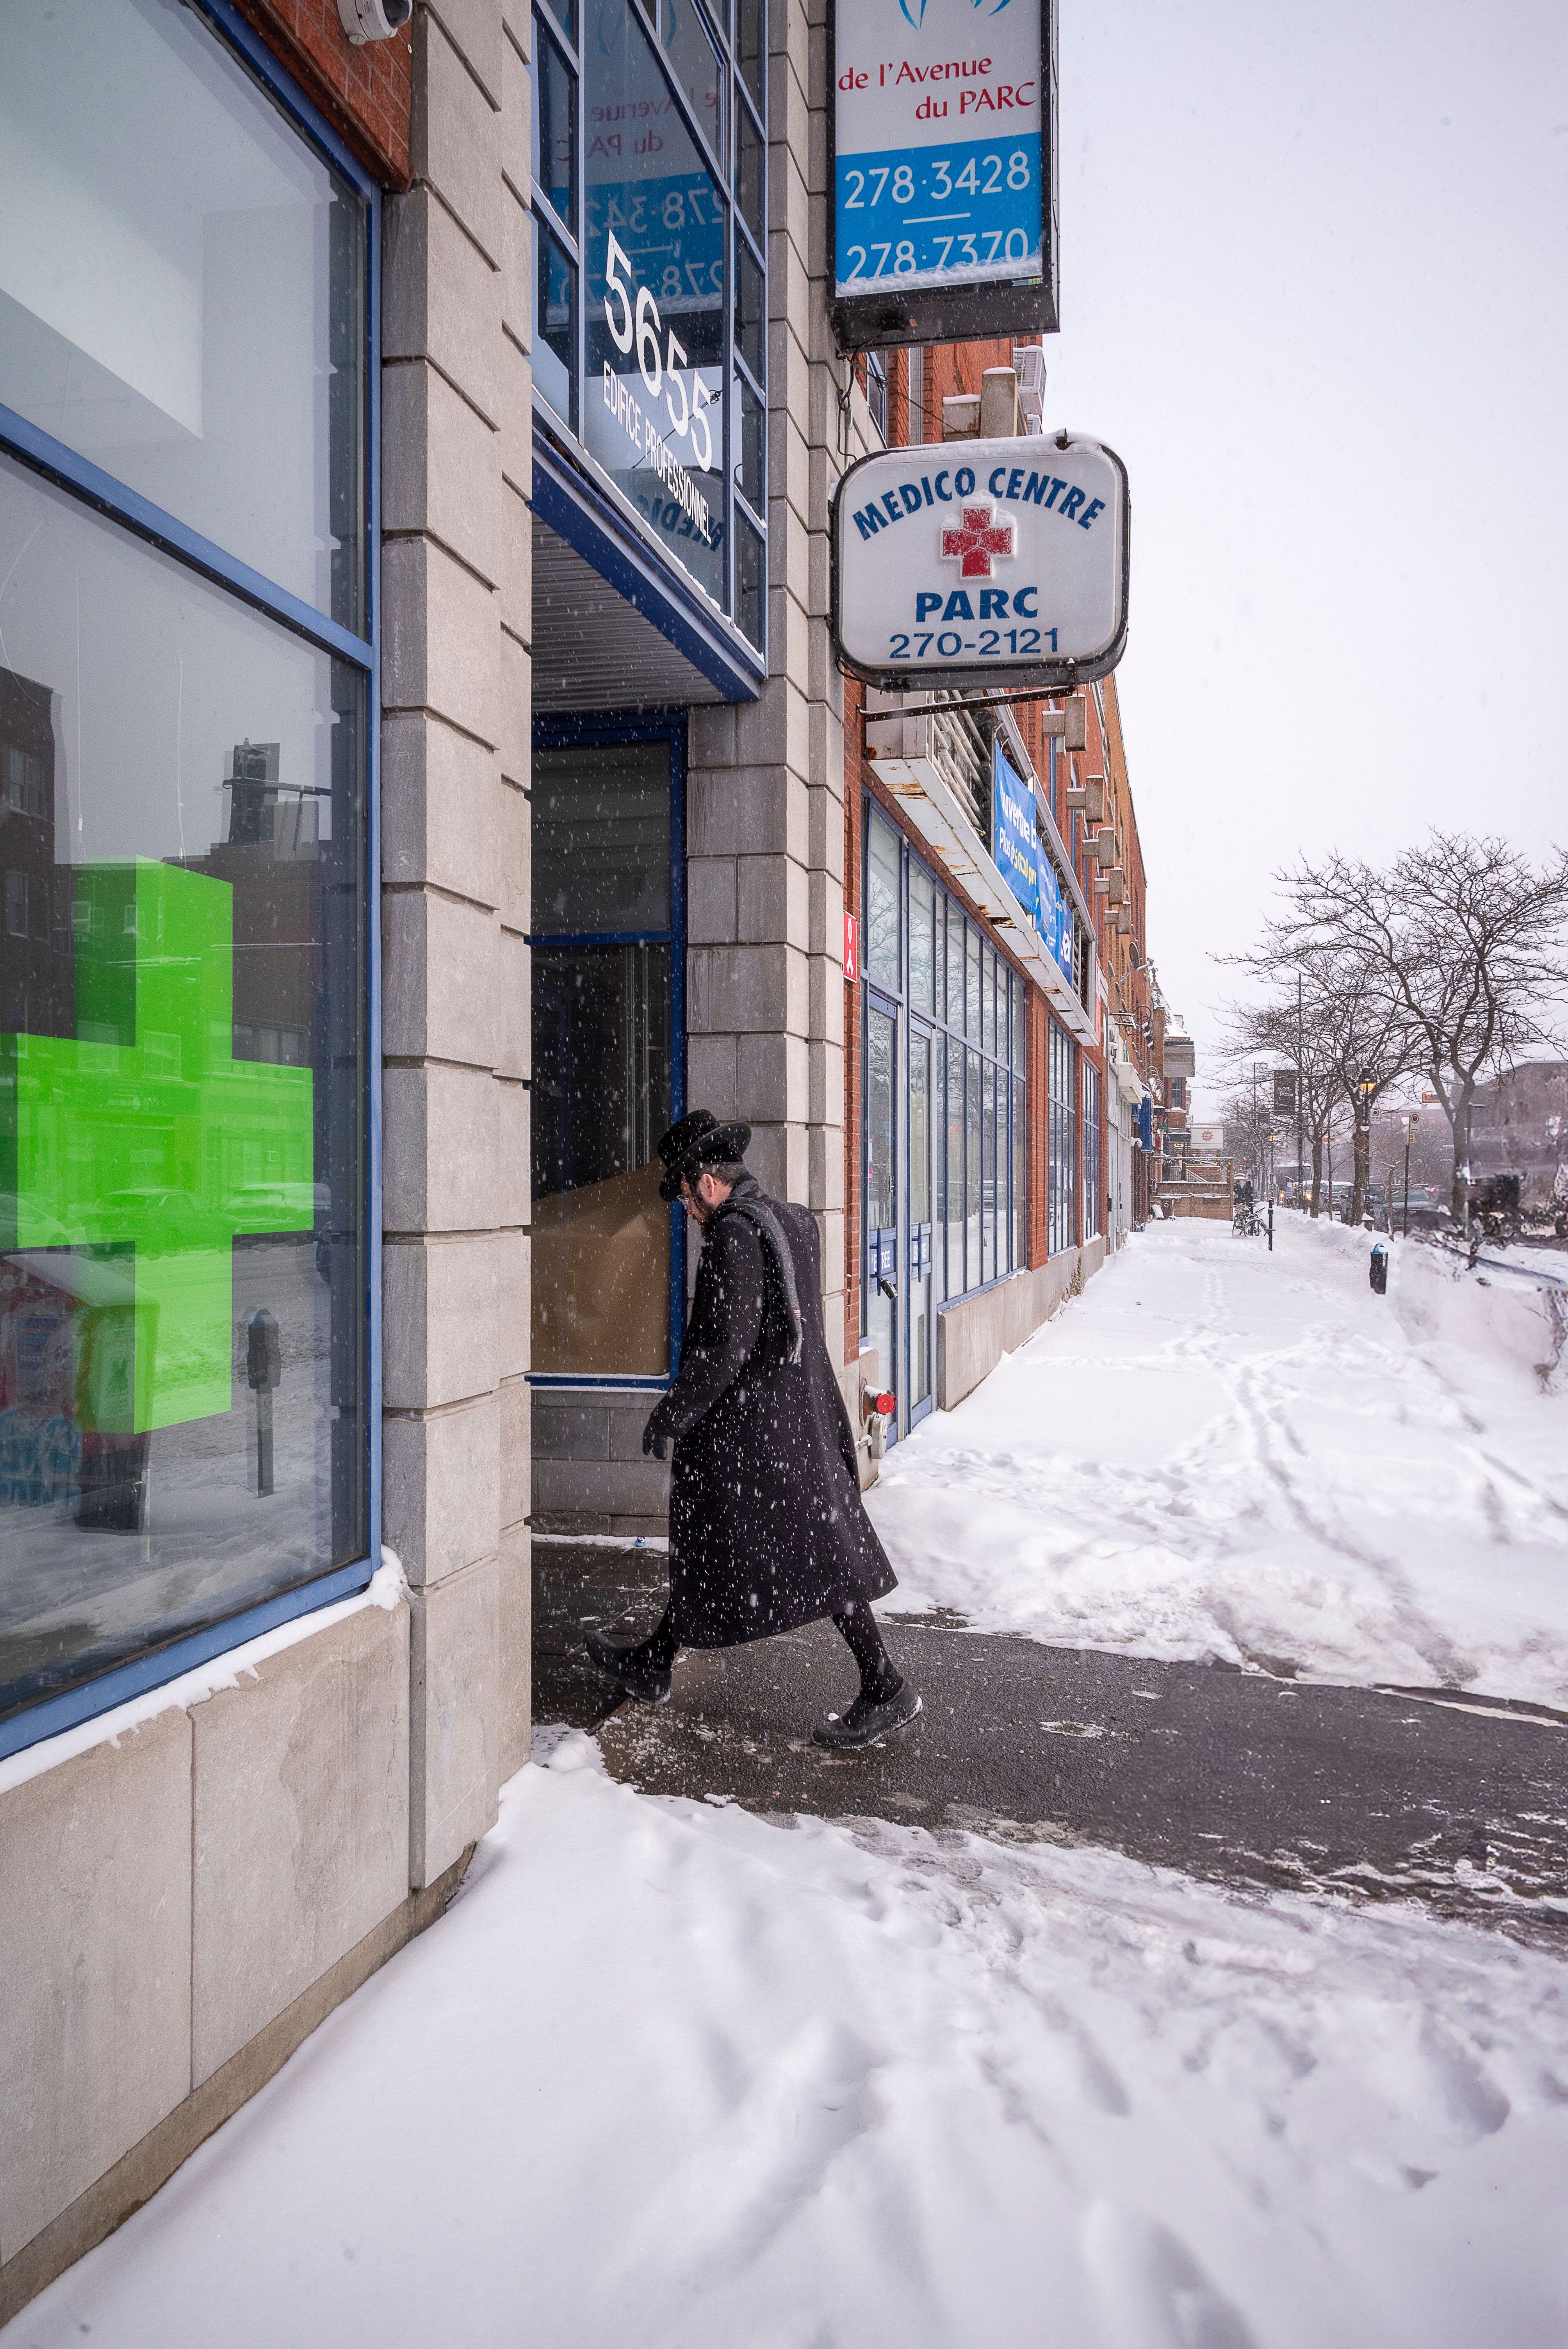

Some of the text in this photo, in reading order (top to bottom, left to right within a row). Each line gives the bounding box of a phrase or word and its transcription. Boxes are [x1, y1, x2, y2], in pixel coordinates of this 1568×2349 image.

[838, 68, 868, 91] de
[915, 82, 1036, 119] du PARC
[604, 229, 713, 472] 5655
[603, 360, 711, 544] EDIFICE PROFESSIONNEL
[852, 467, 1106, 541] MEDICO CENTRE
[916, 586, 1038, 623] PARC
[889, 628, 1058, 659] 270-2121
